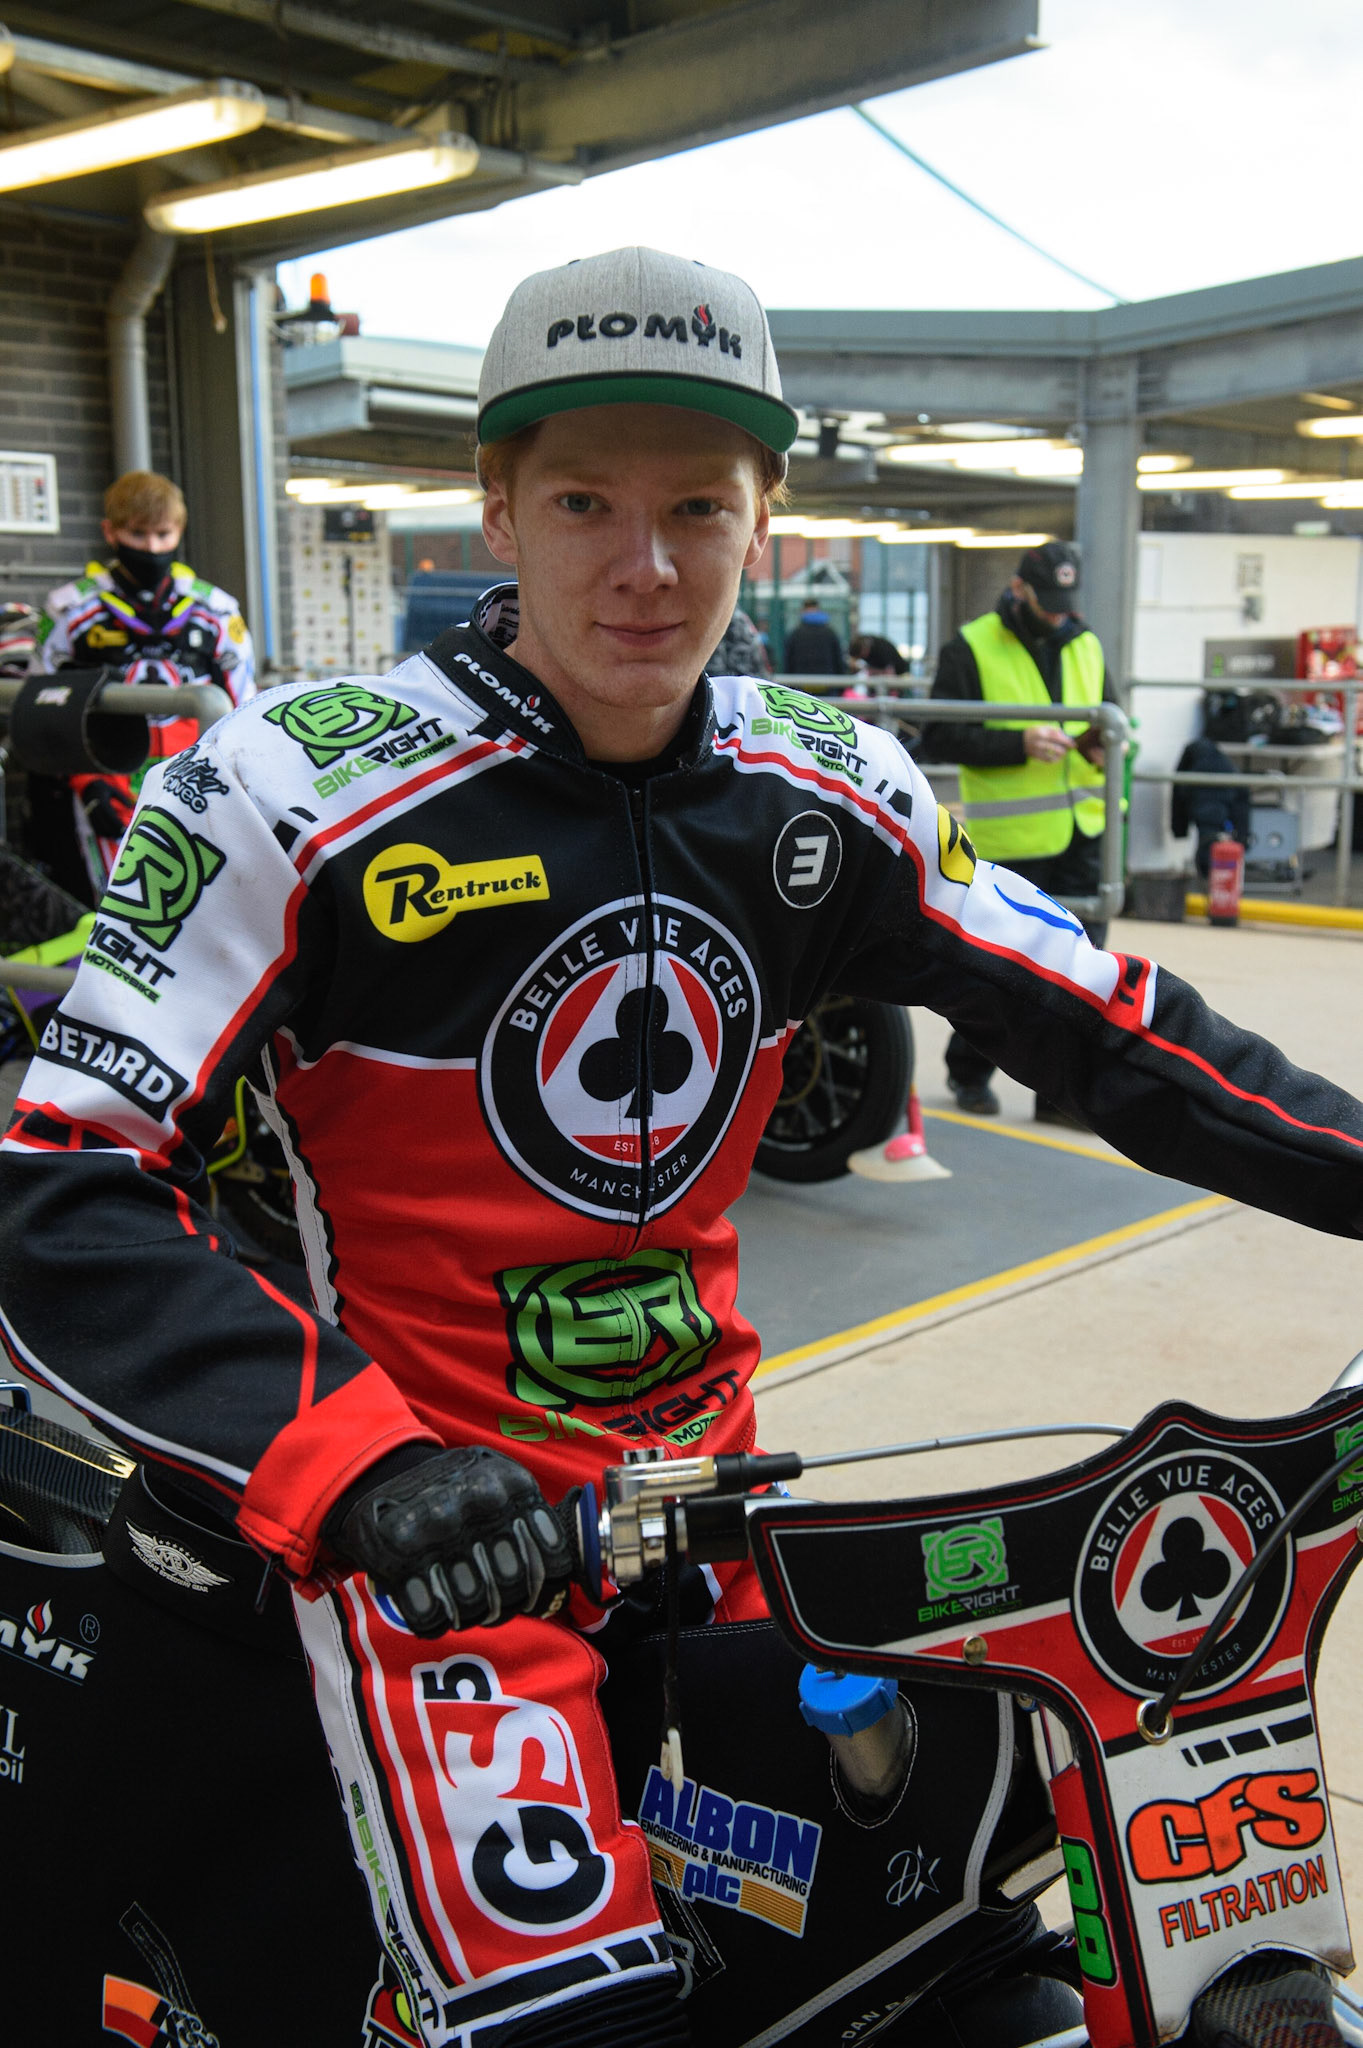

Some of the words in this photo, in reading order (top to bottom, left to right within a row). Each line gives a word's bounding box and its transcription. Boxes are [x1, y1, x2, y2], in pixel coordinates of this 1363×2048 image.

[398, 733, 458, 769] MOTORBIKE
[375, 862, 541, 925] Rentruck
[84, 950, 160, 1002] MOTORBIKE
[87, 919, 176, 986] IGHT
[509, 933, 605, 1032] BELLE
[690, 938, 748, 1018] ACES
[40, 1018, 174, 1102] BETARD
[1090, 1486, 1149, 1572] BELLE
[1157, 1465, 1212, 1491] VUE
[1220, 1474, 1274, 1530] ACES
[1145, 1642, 1243, 1681] MANESTER
[640, 1768, 820, 1883] ALBON
[641, 1819, 699, 1857] ENGINEERING
[700, 1849, 710, 1862] &
[711, 1851, 808, 1896] MANUFACTURING
[1125, 1768, 1327, 1884] CFS
[683, 1862, 741, 1905] plc
[1159, 1854, 1328, 1948] FILTRATION
